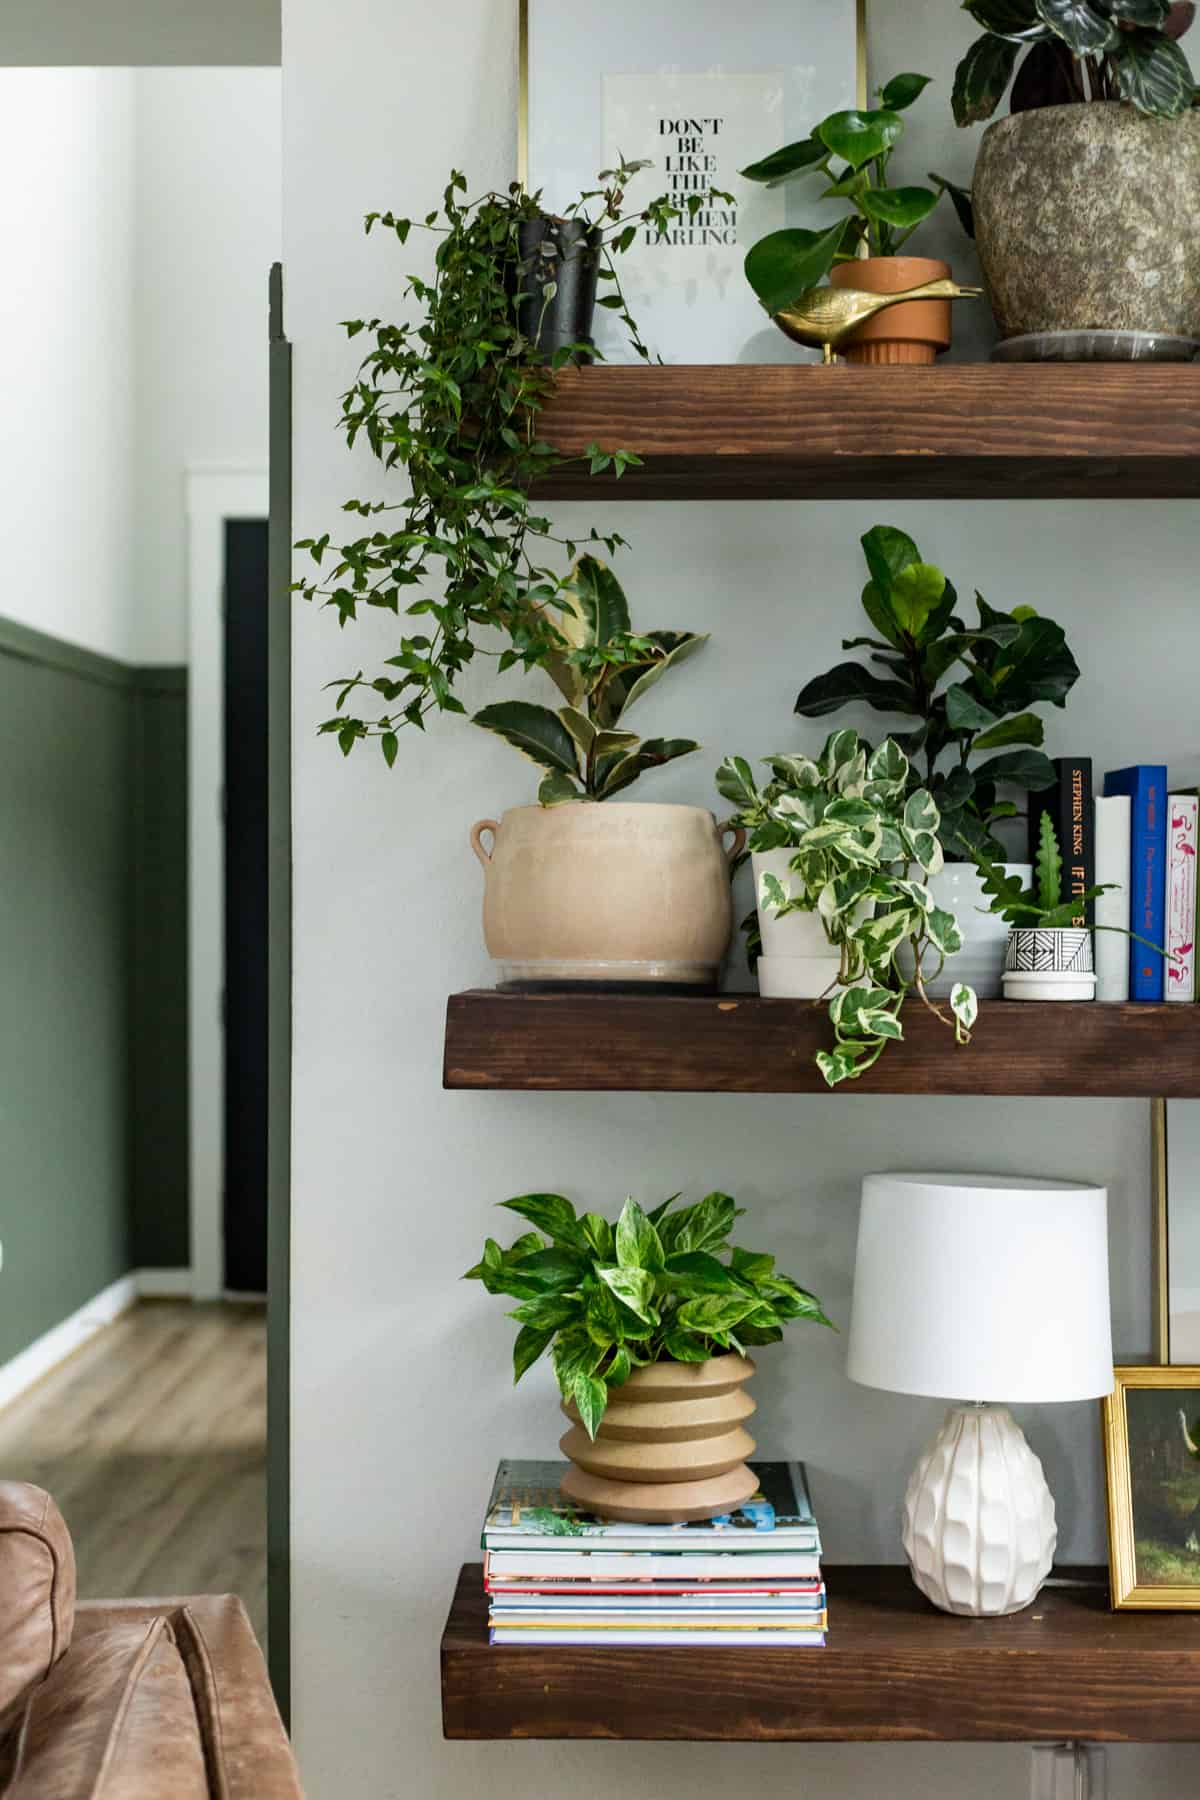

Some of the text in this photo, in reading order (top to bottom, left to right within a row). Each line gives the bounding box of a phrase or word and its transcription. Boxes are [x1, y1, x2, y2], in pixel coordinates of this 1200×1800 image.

[659, 119, 724, 135] DON'T
[678, 138, 705, 153] BE
[665, 156, 717, 172] LIKE
[667, 174, 713, 190] THE
[645, 229, 737, 246] DARLING
[1072, 769, 1084, 856] STEPHEN KING
[1072, 866, 1085, 879] IF
